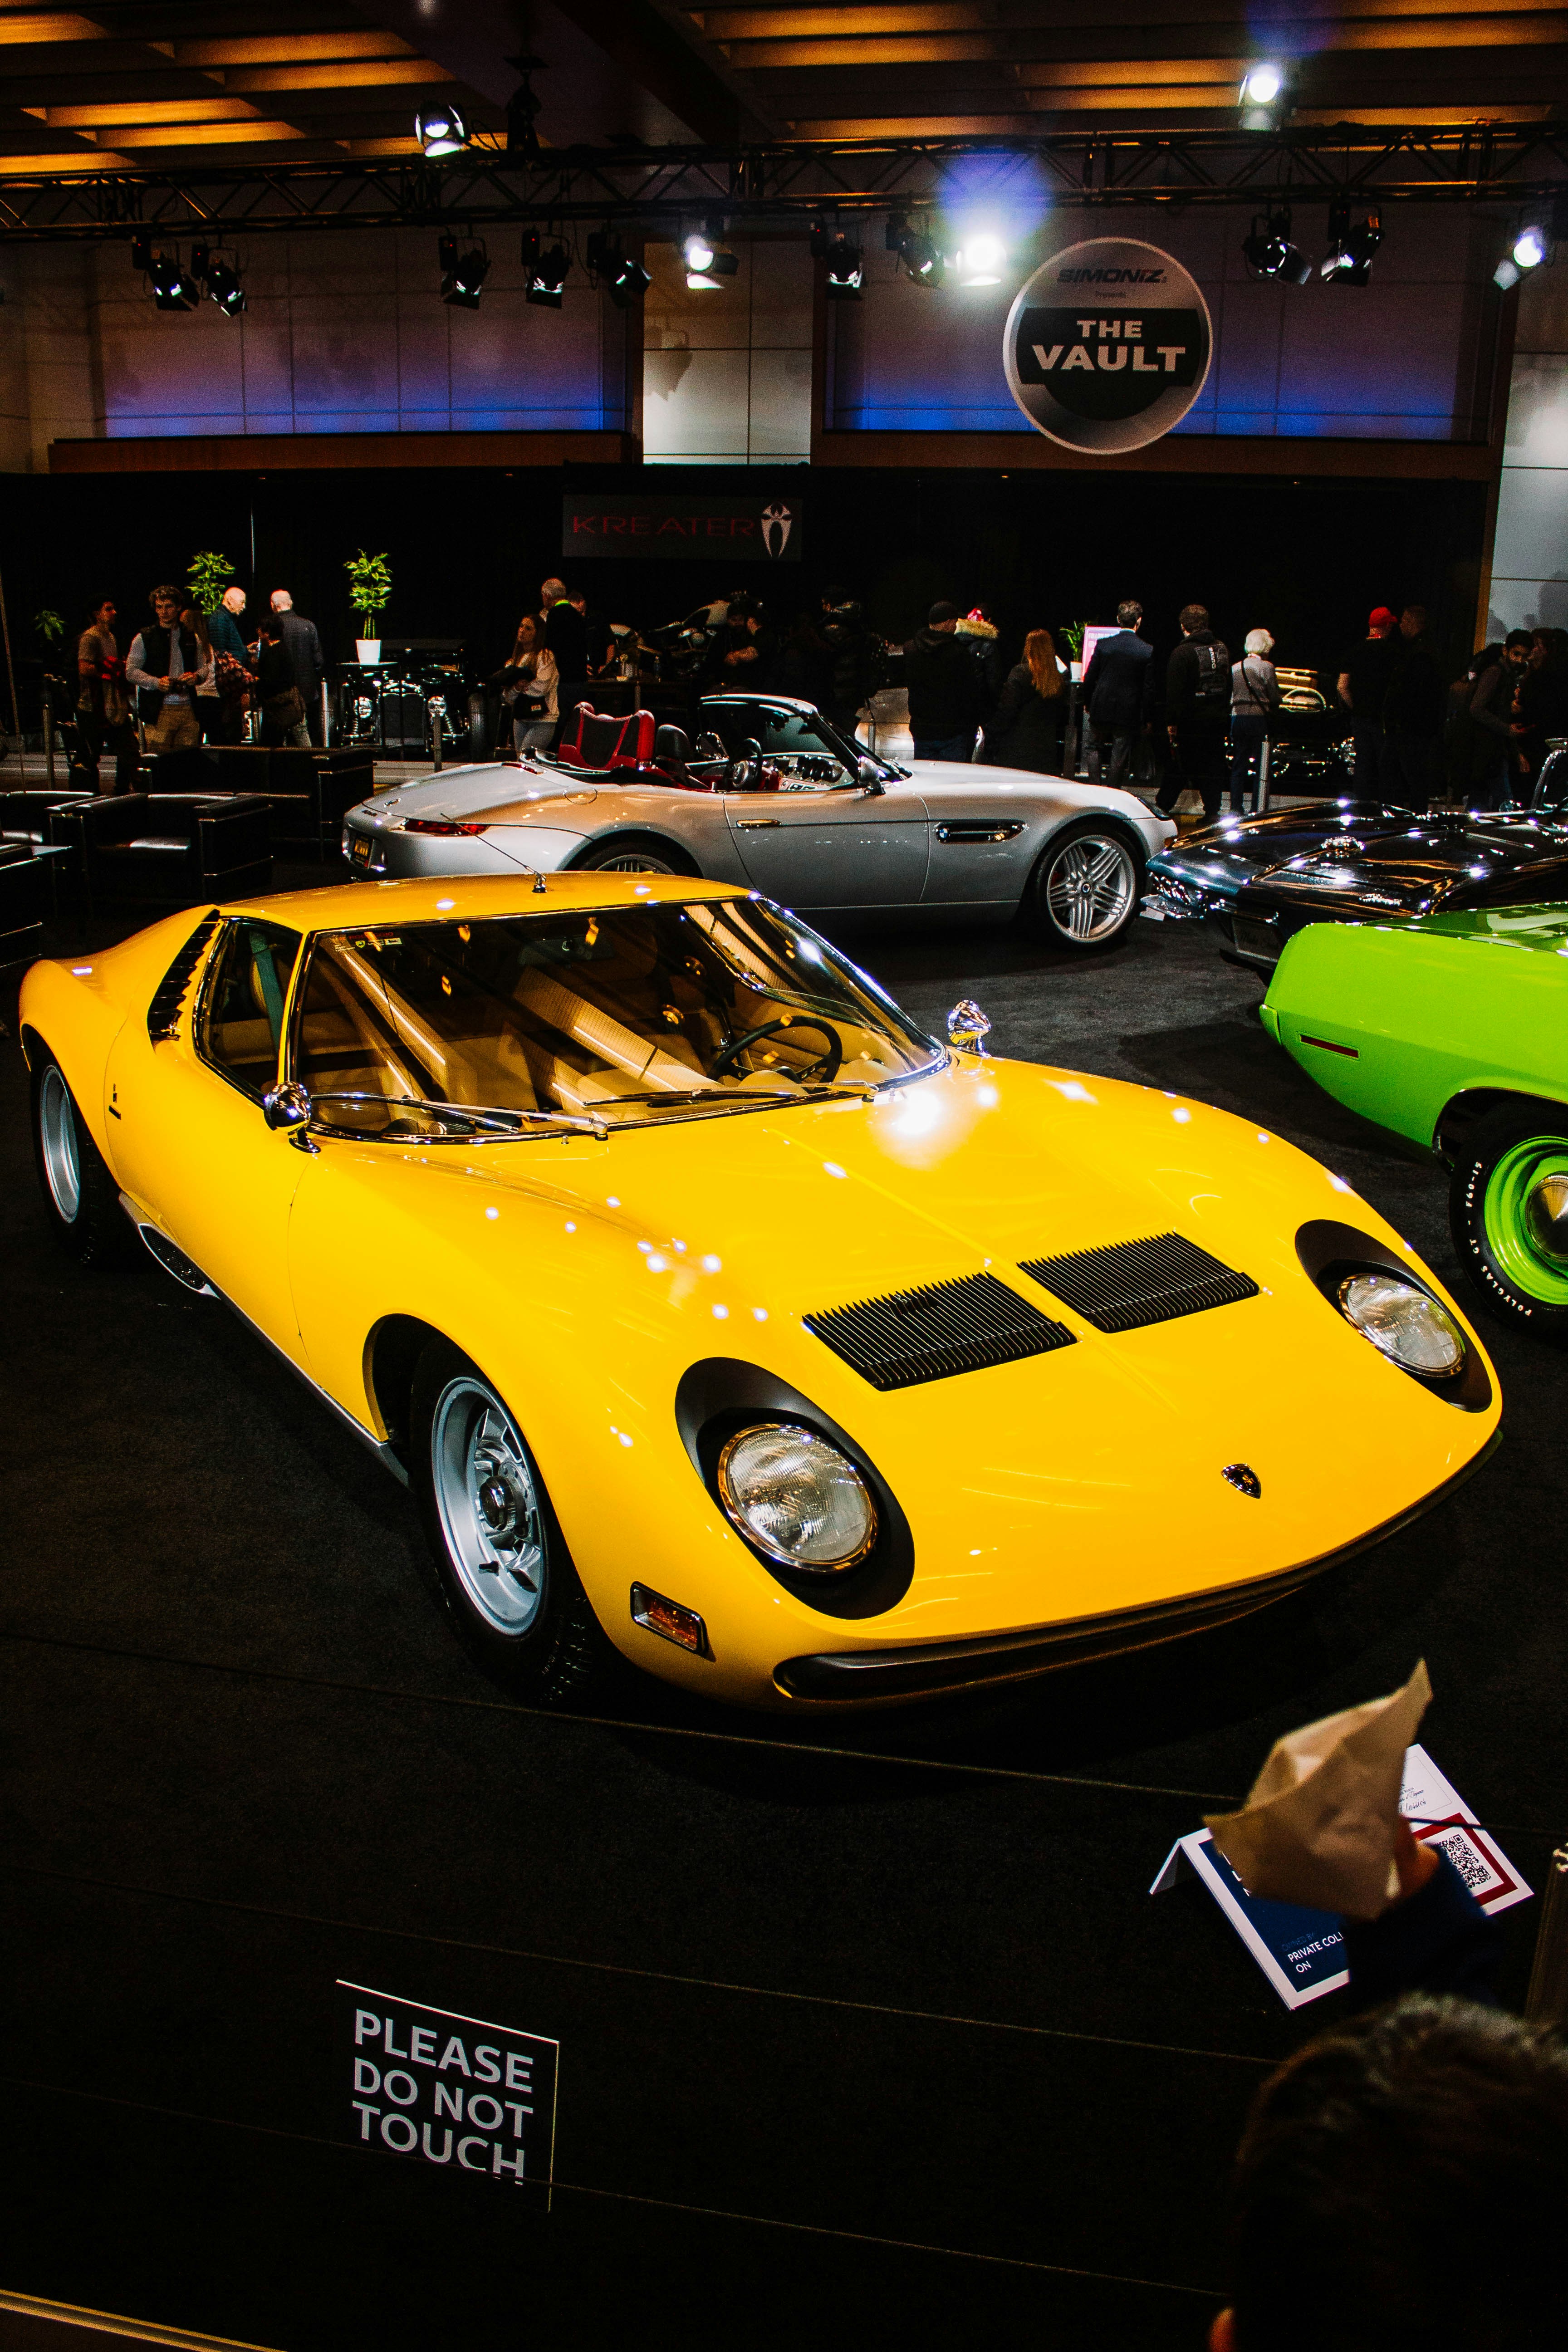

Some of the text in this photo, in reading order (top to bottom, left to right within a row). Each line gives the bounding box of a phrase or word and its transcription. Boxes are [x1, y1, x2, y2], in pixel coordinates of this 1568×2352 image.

[1057, 269, 1165, 283] SIMONIZ
[1077, 320, 1142, 338] THE
[1032, 344, 1186, 371] VAULT
[573, 516, 755, 536] KREATER
[1465, 1161, 1482, 1207] F60-15
[1470, 1239, 1480, 1254] GT
[1481, 1265, 1532, 1316] POLYGLAS
[1288, 1941, 1323, 1962] PRIVATE
[1296, 1960, 1312, 1973] ON
[354, 2009, 534, 2093] PLEASE
[354, 2057, 534, 2138] DO NOT
[352, 2100, 524, 2185] TOUCH
